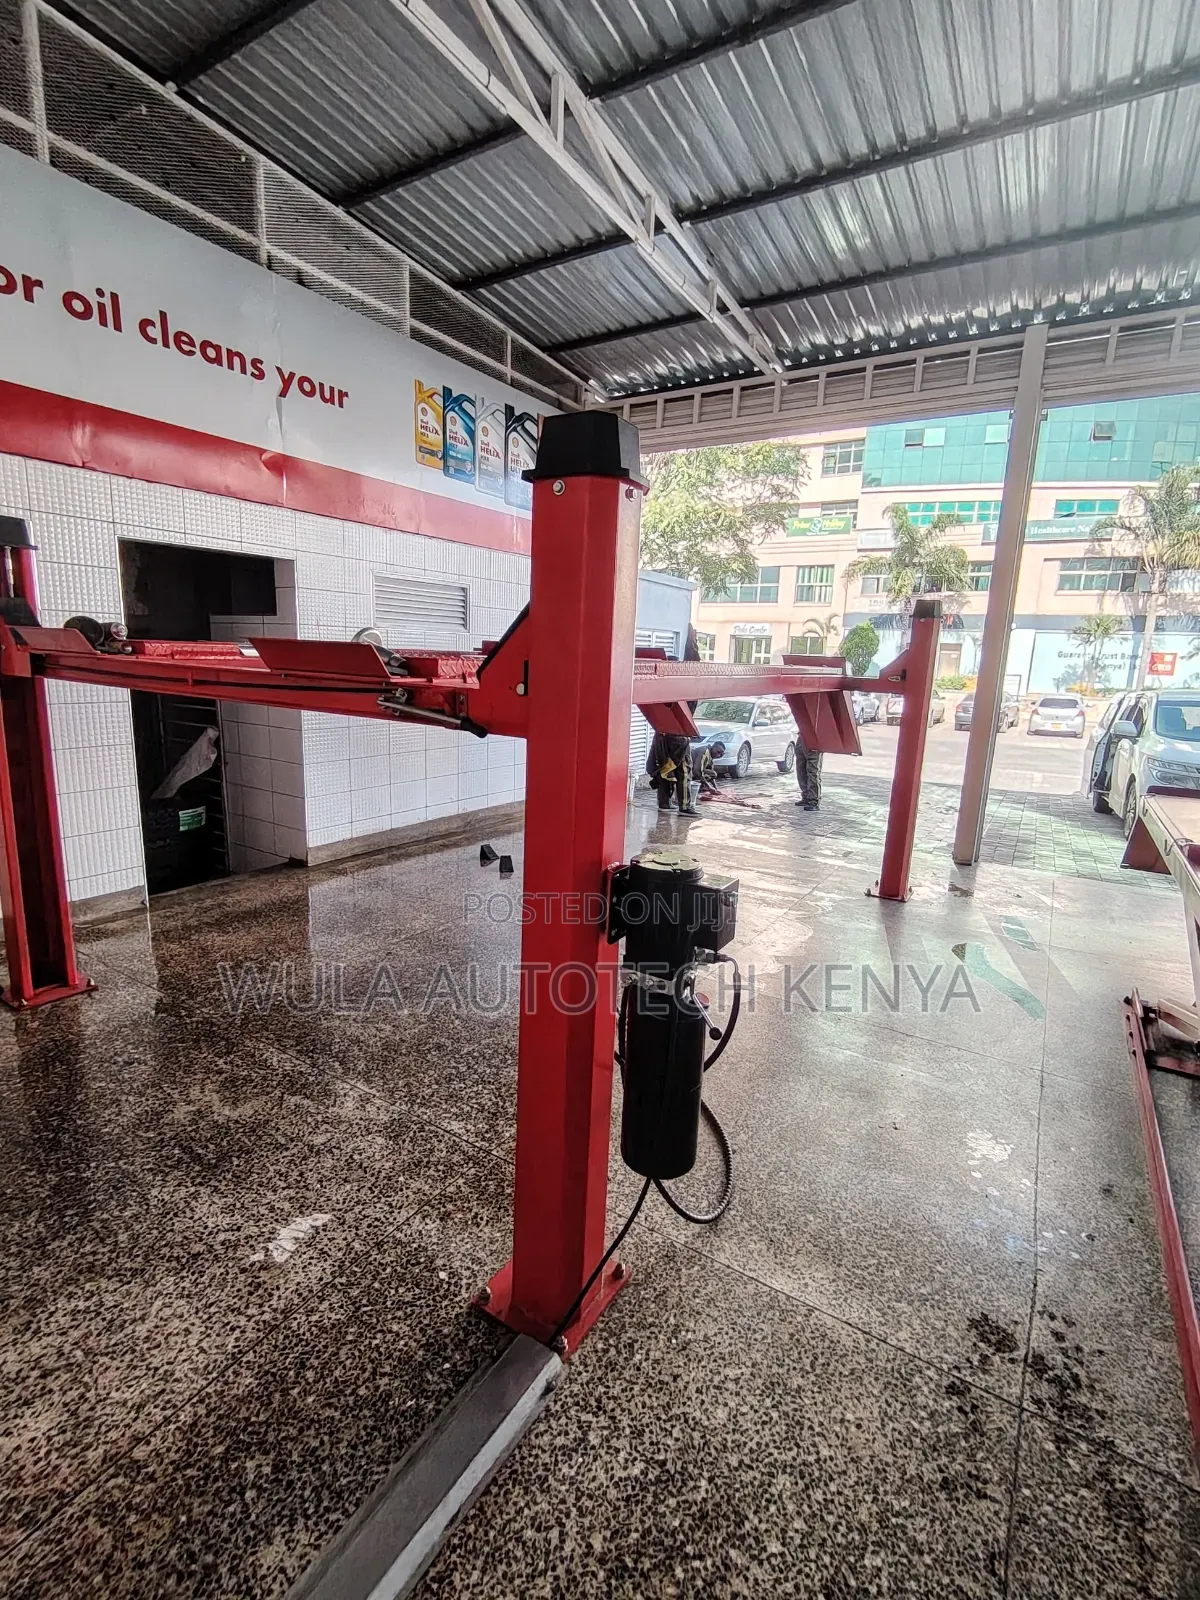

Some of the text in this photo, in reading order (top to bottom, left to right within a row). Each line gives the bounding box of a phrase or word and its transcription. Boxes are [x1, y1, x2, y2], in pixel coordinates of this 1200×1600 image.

[62, 287, 123, 333] oil
[138, 309, 266, 381] cleans
[274, 365, 349, 409] your
[420, 423, 440, 436] HELIX
[448, 433, 469, 447] HELIX
[480, 446, 501, 460] HELIX
[510, 458, 530, 469] HELIX
[1031, 525, 1075, 535] Healthcare
